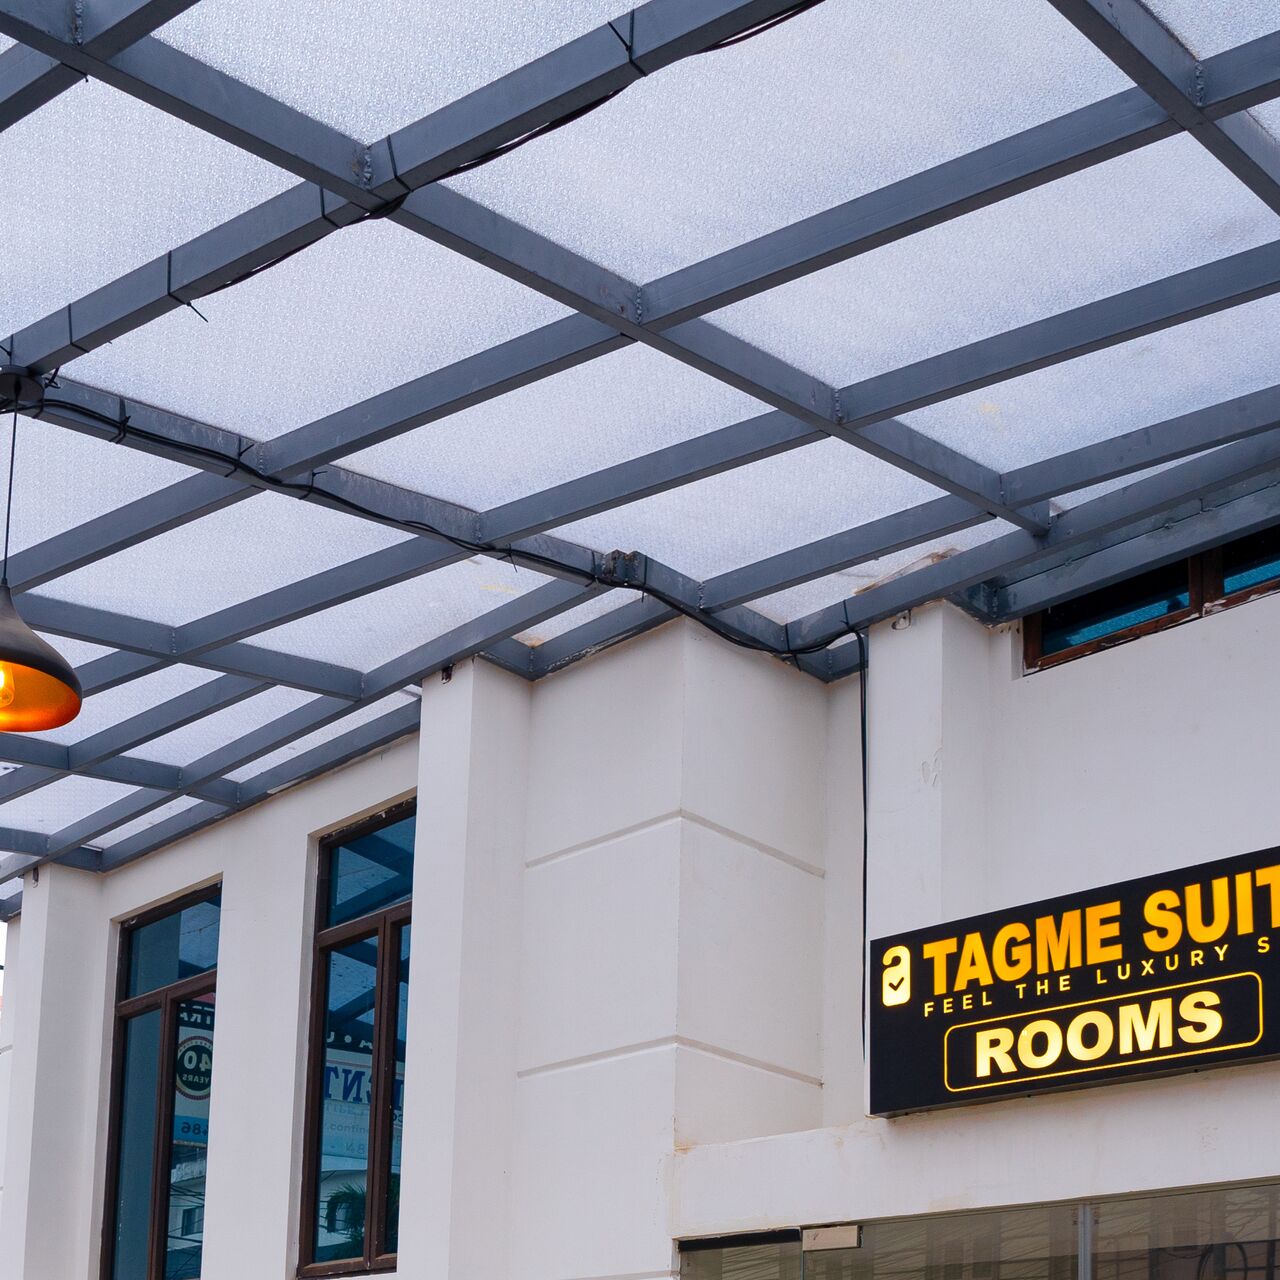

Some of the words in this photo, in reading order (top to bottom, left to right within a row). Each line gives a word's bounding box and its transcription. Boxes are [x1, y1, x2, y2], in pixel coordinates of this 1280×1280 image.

[923, 900, 1122, 996] TAGME
[924, 991, 993, 1018] FEEL
[1016, 974, 1071, 999] THE
[1097, 944, 1229, 985] LUXURY
[975, 990, 1223, 1078] ROOMS
